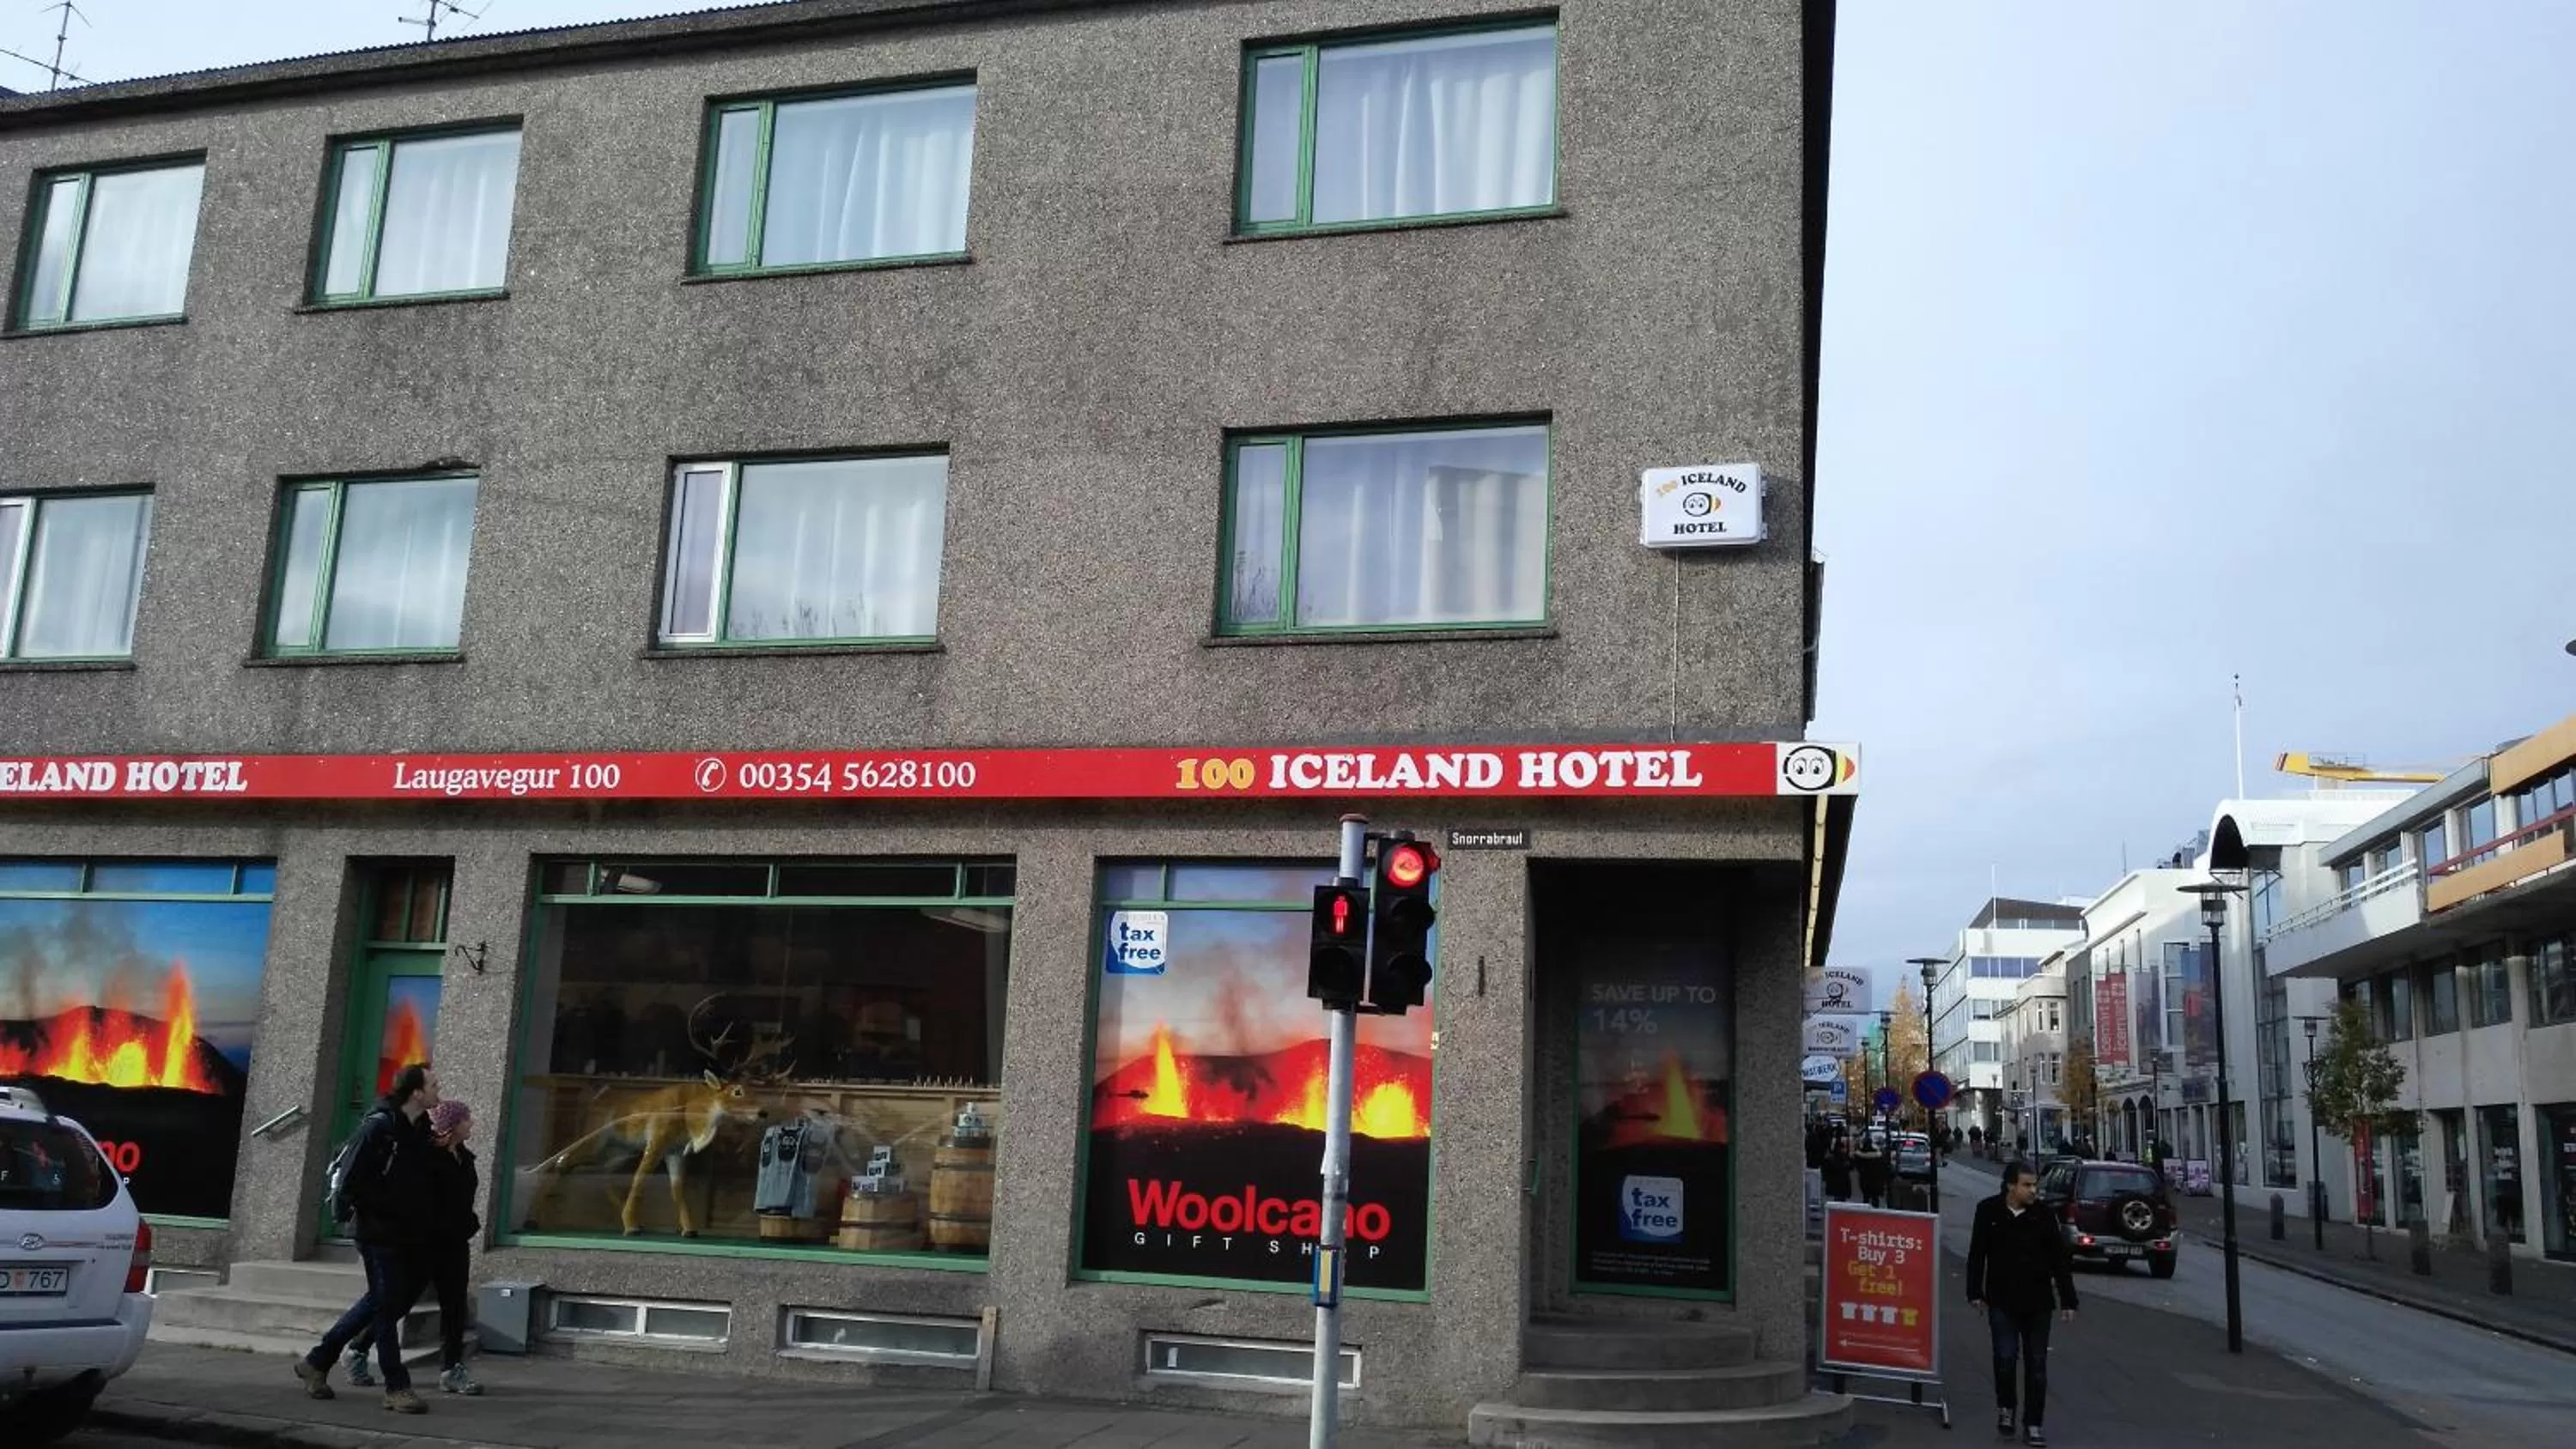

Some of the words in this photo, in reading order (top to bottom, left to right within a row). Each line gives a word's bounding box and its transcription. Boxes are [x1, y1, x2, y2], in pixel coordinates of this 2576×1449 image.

[1680, 471, 1747, 494] ICELAND
[1674, 521, 1727, 535] HOTEL
[124, 761, 248, 791] HOTEL
[393, 762, 560, 794] Laugavegur
[569, 764, 621, 790] 100
[739, 762, 832, 792] 00354
[841, 761, 976, 792] 5628100
[1175, 757, 1256, 790] 100
[1268, 752, 1504, 790] ICELAND
[1517, 749, 1703, 789] HOTEL
[1119, 921, 1155, 942] tax
[1118, 943, 1162, 961] free
[1591, 983, 1646, 1003] SAVE
[1651, 985, 1680, 1003] UP
[1684, 985, 1717, 1003] TO
[1593, 1008, 1659, 1034] 14%
[1631, 1187, 1670, 1209] tax
[1631, 1209, 1678, 1230] free
[1133, 1231, 1232, 1251] GIFT
[1270, 1240, 1380, 1259] SHP
[1840, 1228, 1923, 1251] T-shirts:
[1857, 1246, 1886, 1265] Buy
[1895, 1250, 1905, 1264] 3
[29, 1270, 64, 1288] 767
[1847, 1262, 1876, 1276] Get
[1886, 1264, 1896, 1278] 1
